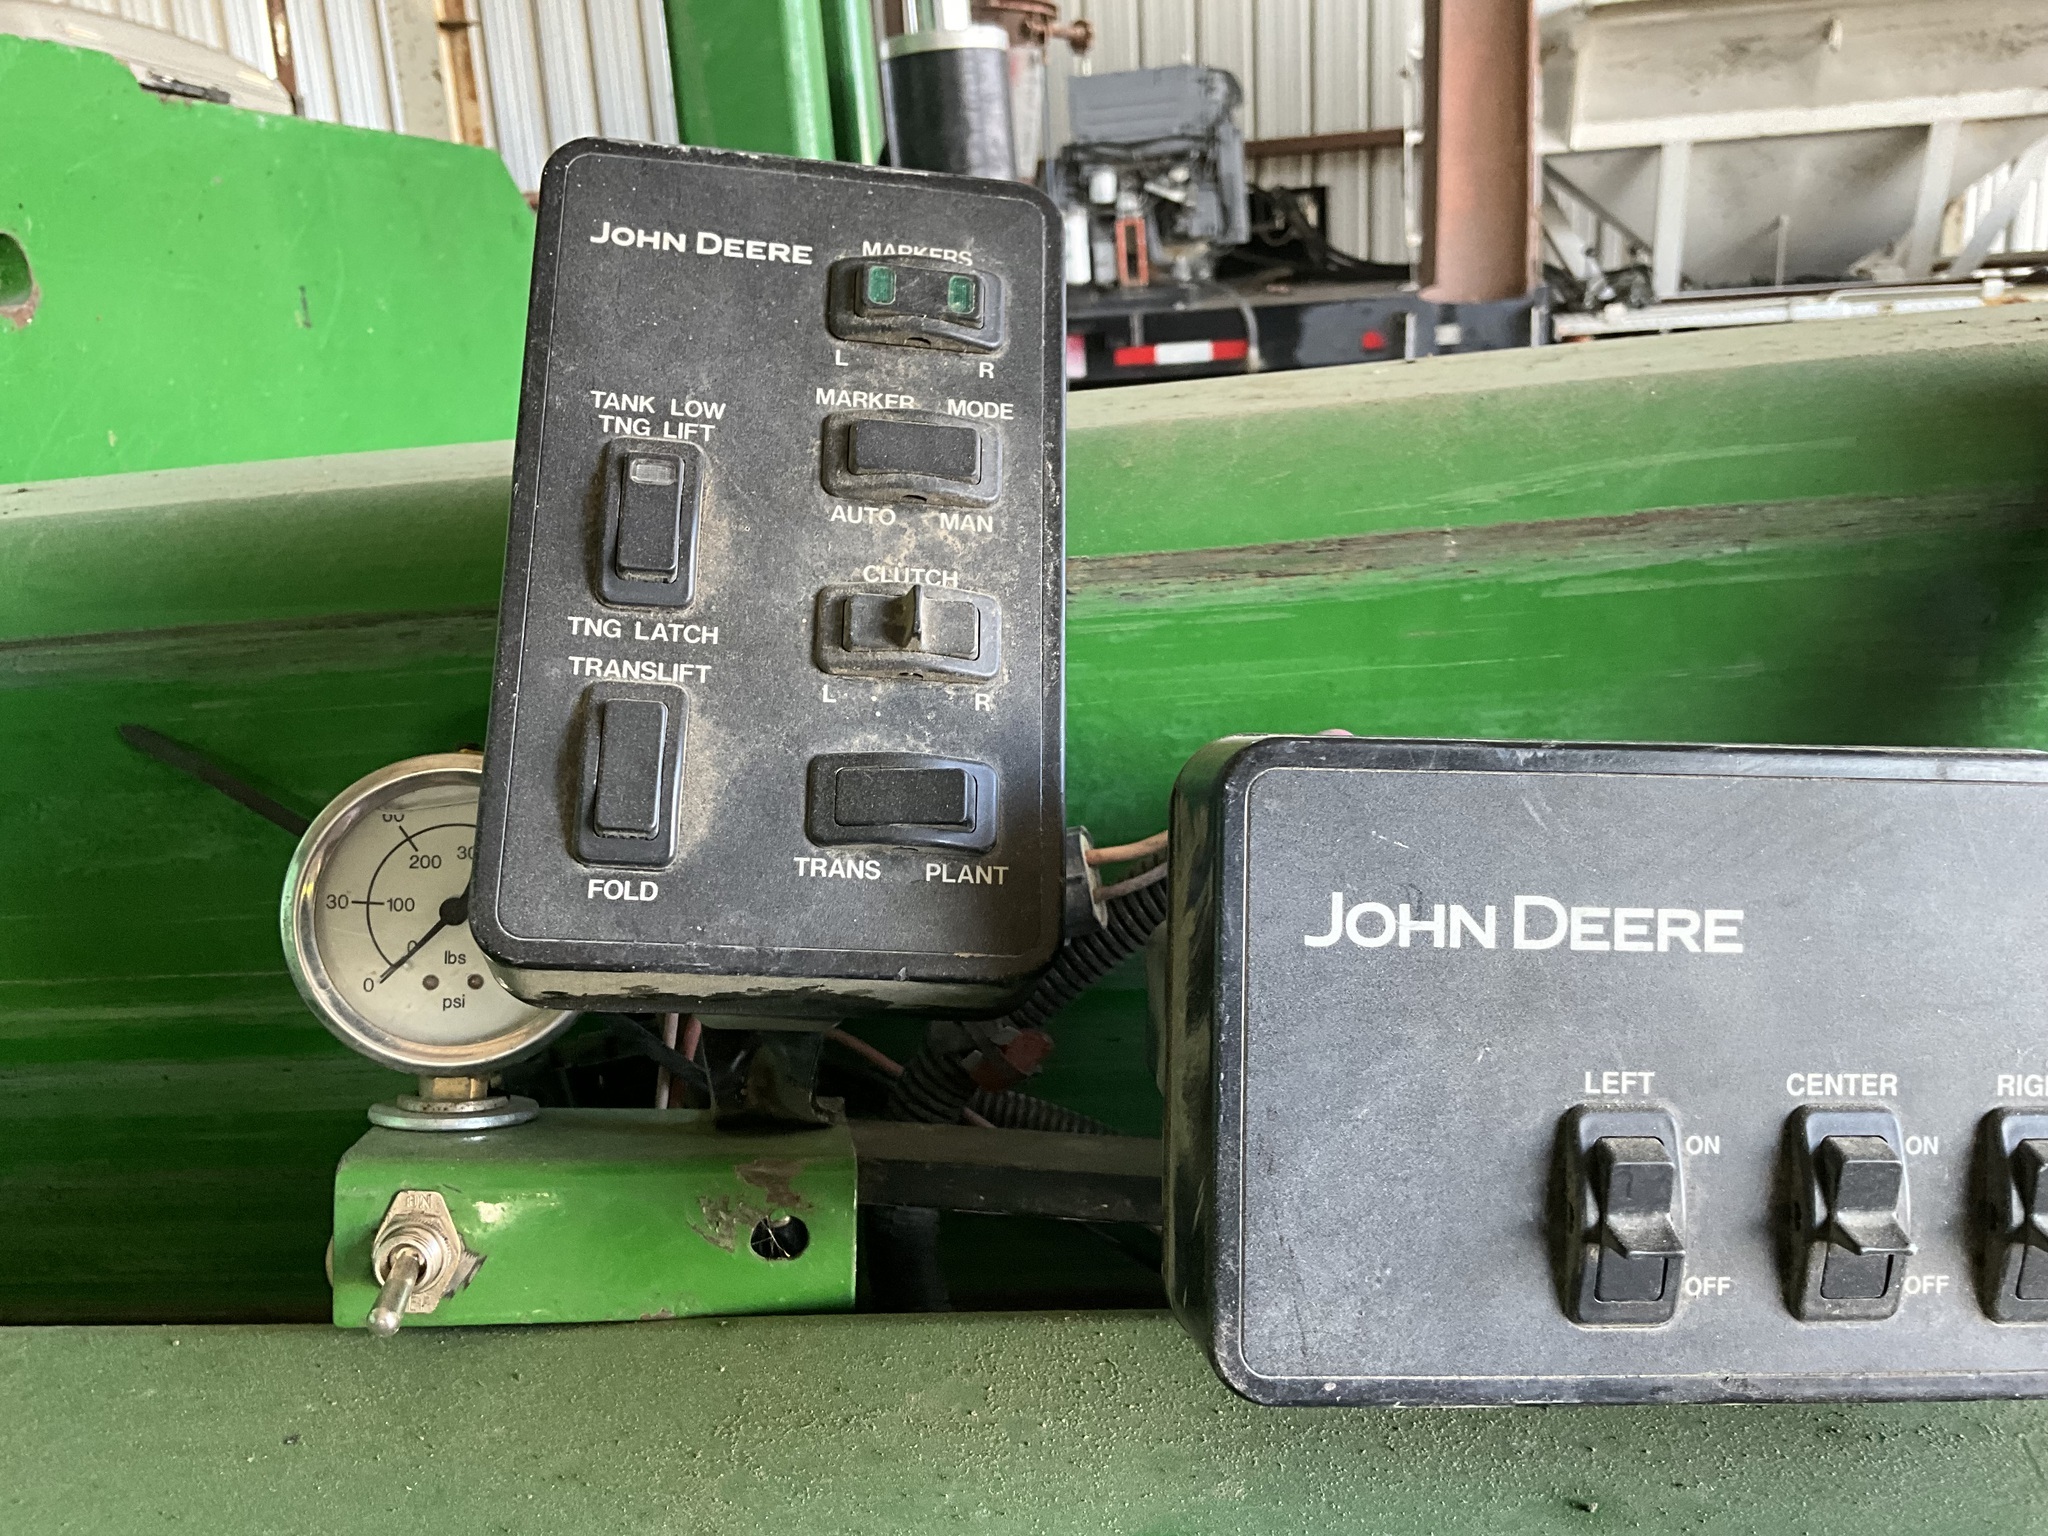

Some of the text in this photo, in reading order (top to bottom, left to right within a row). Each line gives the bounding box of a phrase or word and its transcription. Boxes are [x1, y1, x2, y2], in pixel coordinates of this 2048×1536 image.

[589, 221, 813, 265] JOHN DEERE
[862, 241, 973, 267] MARKERS
[835, 348, 995, 379] L R
[590, 390, 726, 420] TANK LOW
[815, 387, 1015, 421] MARKER MODE
[598, 414, 715, 442] TNG LIFT
[829, 504, 993, 533] AUTO MAN
[863, 565, 959, 588] CLUTCH
[567, 616, 719, 645] TNG LATCH
[568, 656, 712, 684] TRANSLIFT
[822, 684, 991, 712] L R
[409, 855, 442, 869] 200
[793, 856, 1009, 886] TRANS PLANT
[325, 894, 349, 909] 30
[587, 878, 659, 902] FOLD
[386, 899, 416, 913] 100
[1303, 891, 1744, 954] JOHN DEERE
[444, 950, 467, 965] lbs
[363, 977, 375, 993] 0
[442, 994, 466, 1012] psi
[1584, 1071, 1656, 1095] LEFT
[1786, 1073, 1898, 1097] CENTER
[1997, 1073, 2048, 1097] RIG
[1685, 1135, 1720, 1156] ON
[1905, 1135, 1939, 1156] ON
[1684, 1275, 1731, 1297] OFF
[1904, 1274, 1950, 1295] OFF
